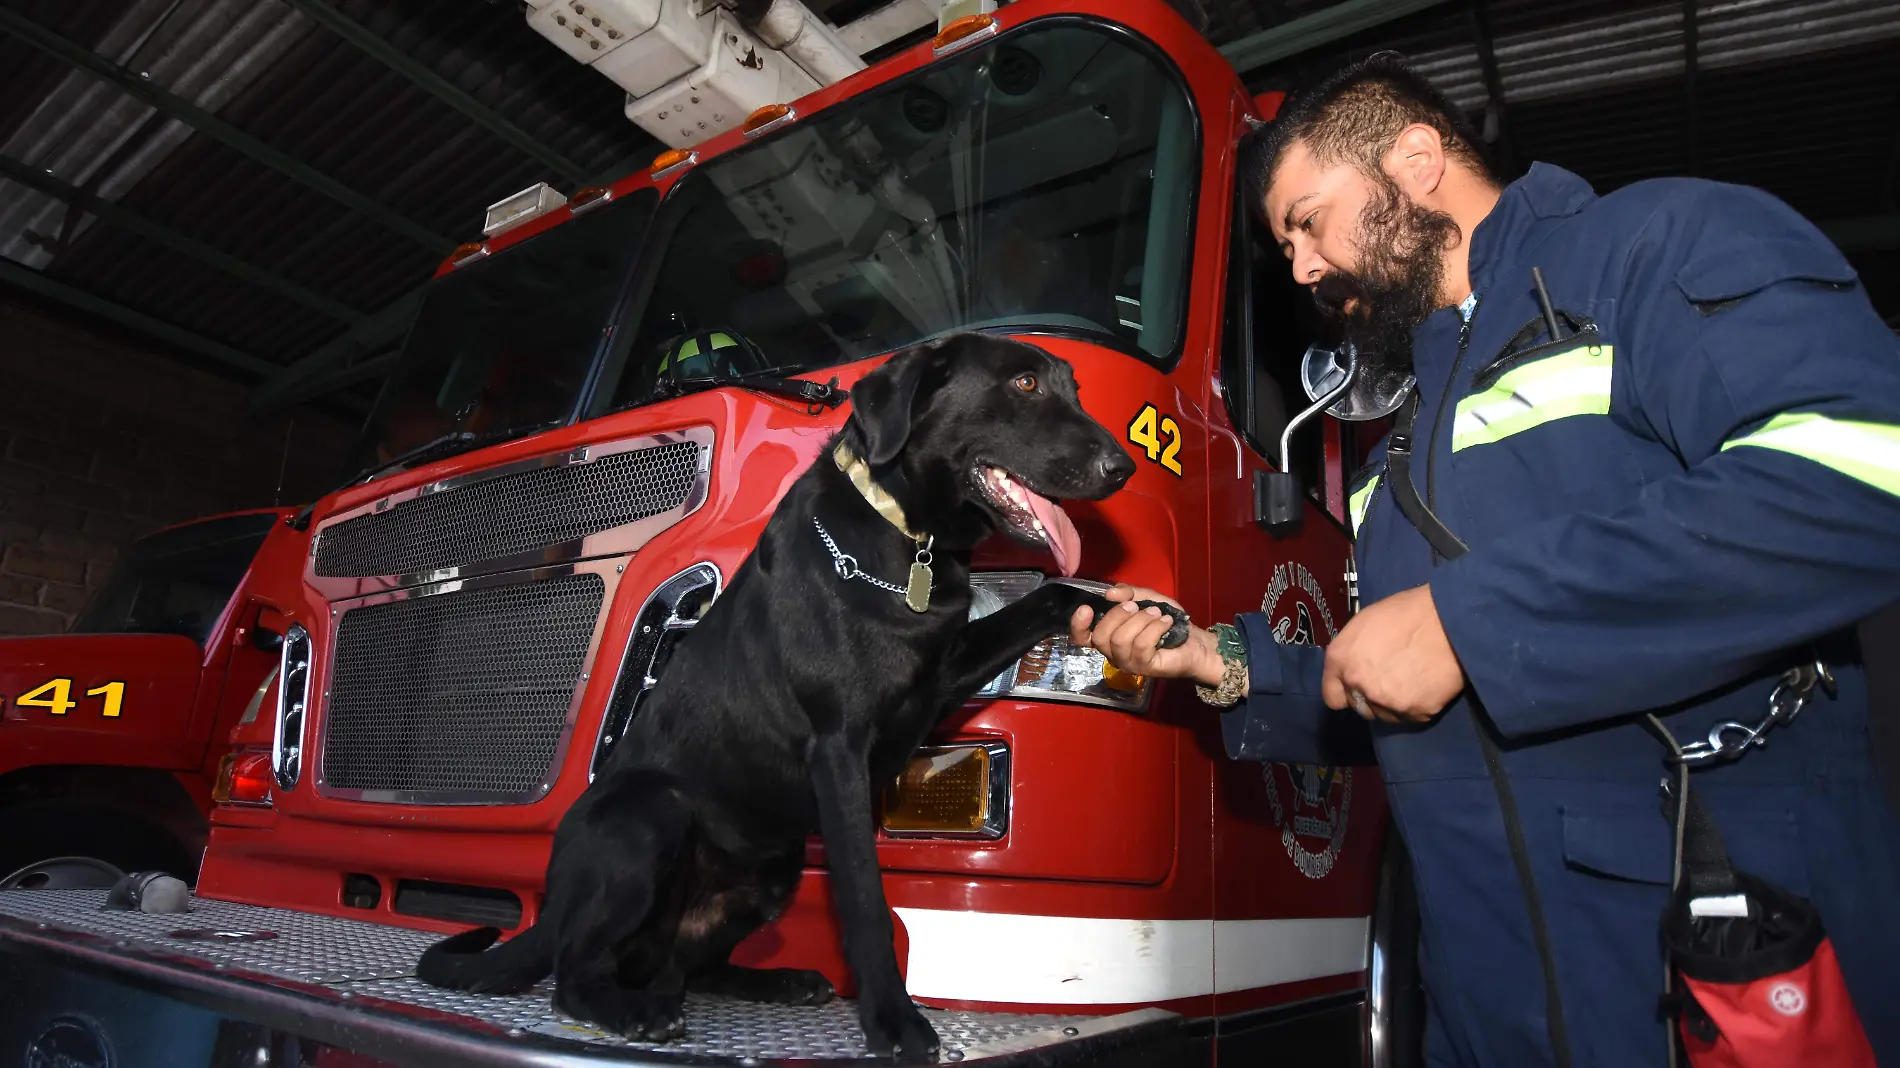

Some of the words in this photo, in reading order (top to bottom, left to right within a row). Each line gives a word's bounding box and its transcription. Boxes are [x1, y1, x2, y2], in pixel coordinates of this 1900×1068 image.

[1128, 402, 1182, 478] 42
[1297, 563, 1338, 640] PROTECCI
[15, 677, 126, 718] 41
